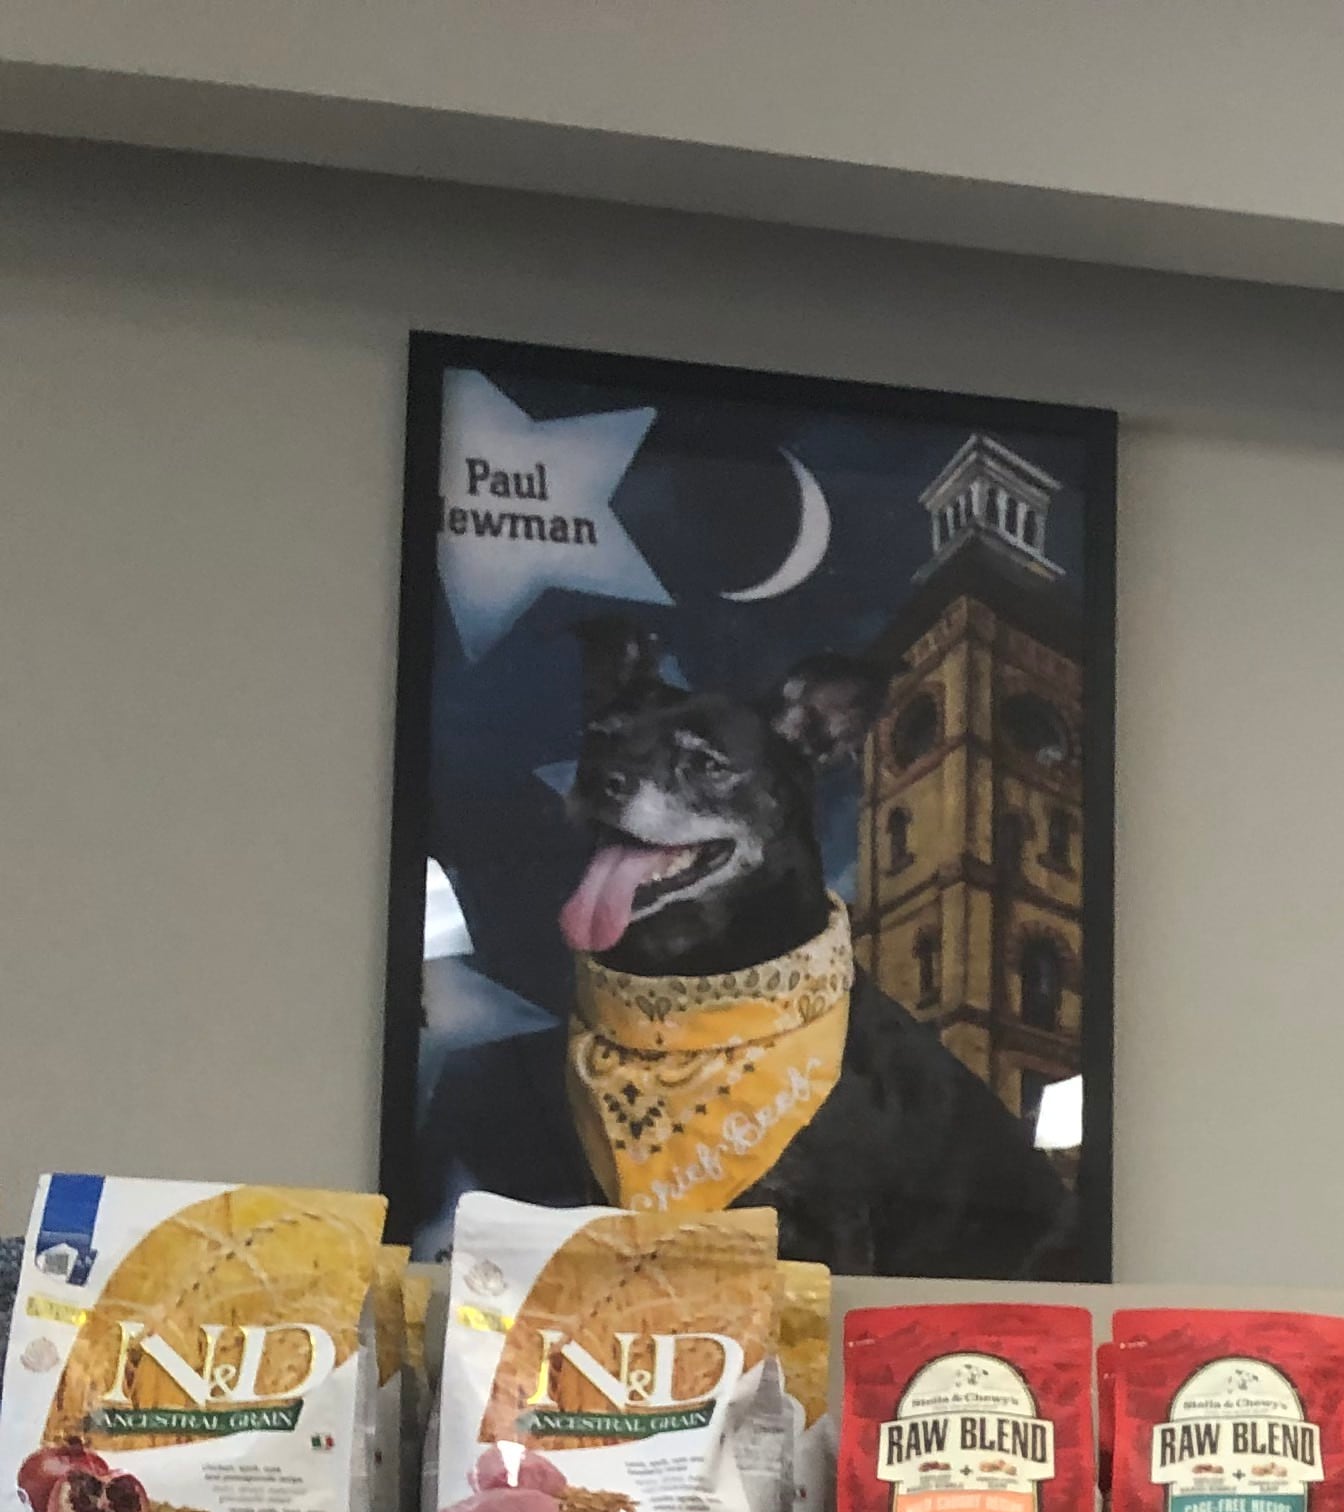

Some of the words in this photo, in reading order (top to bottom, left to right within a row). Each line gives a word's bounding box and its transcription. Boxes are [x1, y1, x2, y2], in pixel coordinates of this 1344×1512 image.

[466, 456, 550, 501] Paul
[440, 496, 599, 547] ewman
[98, 1320, 336, 1409] N&D
[527, 1328, 745, 1411] N&D
[102, 1412, 224, 1430] ANCESTRAL
[229, 1410, 293, 1429] GRAIN
[530, 1415, 645, 1432] ANCESTRAL
[650, 1411, 708, 1430] GRAIN
[886, 1418, 949, 1466] RAW
[960, 1417, 1048, 1464] BLEND
[1160, 1422, 1221, 1467] RAW
[1232, 1421, 1315, 1467] BLEND
